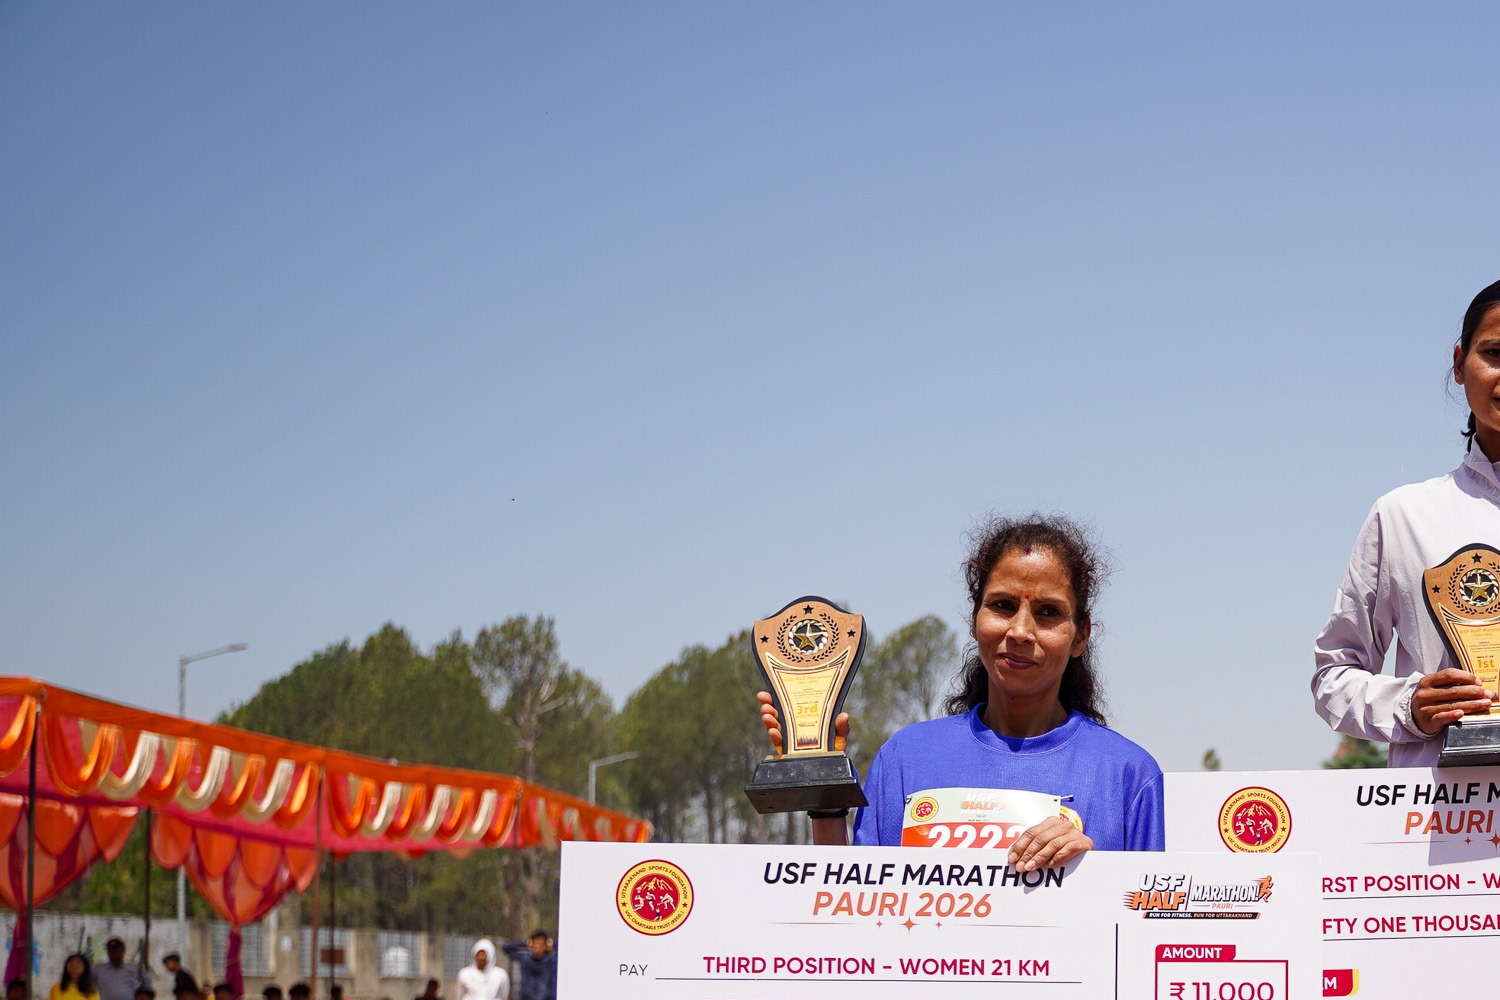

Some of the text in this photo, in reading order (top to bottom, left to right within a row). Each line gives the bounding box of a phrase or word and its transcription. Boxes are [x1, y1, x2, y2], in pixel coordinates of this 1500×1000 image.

[1477, 659, 1495, 668] 1st
[797, 704, 818, 714] 3rd
[1356, 784, 1406, 807] USF
[1413, 782, 1480, 805] HALF
[1404, 810, 1494, 835] PAURI
[764, 862, 1065, 888] USF HALF MARATHON
[1138, 873, 1186, 892] USF
[1364, 874, 1460, 891] POSITION
[813, 892, 992, 918] PAURI 2026
[1131, 891, 1187, 910] HALF
[1364, 916, 1406, 933] ONE
[1162, 947, 1222, 959] AMOUNT
[619, 957, 1049, 976] PAY THIRD POSITION WOMEN 21 KM
